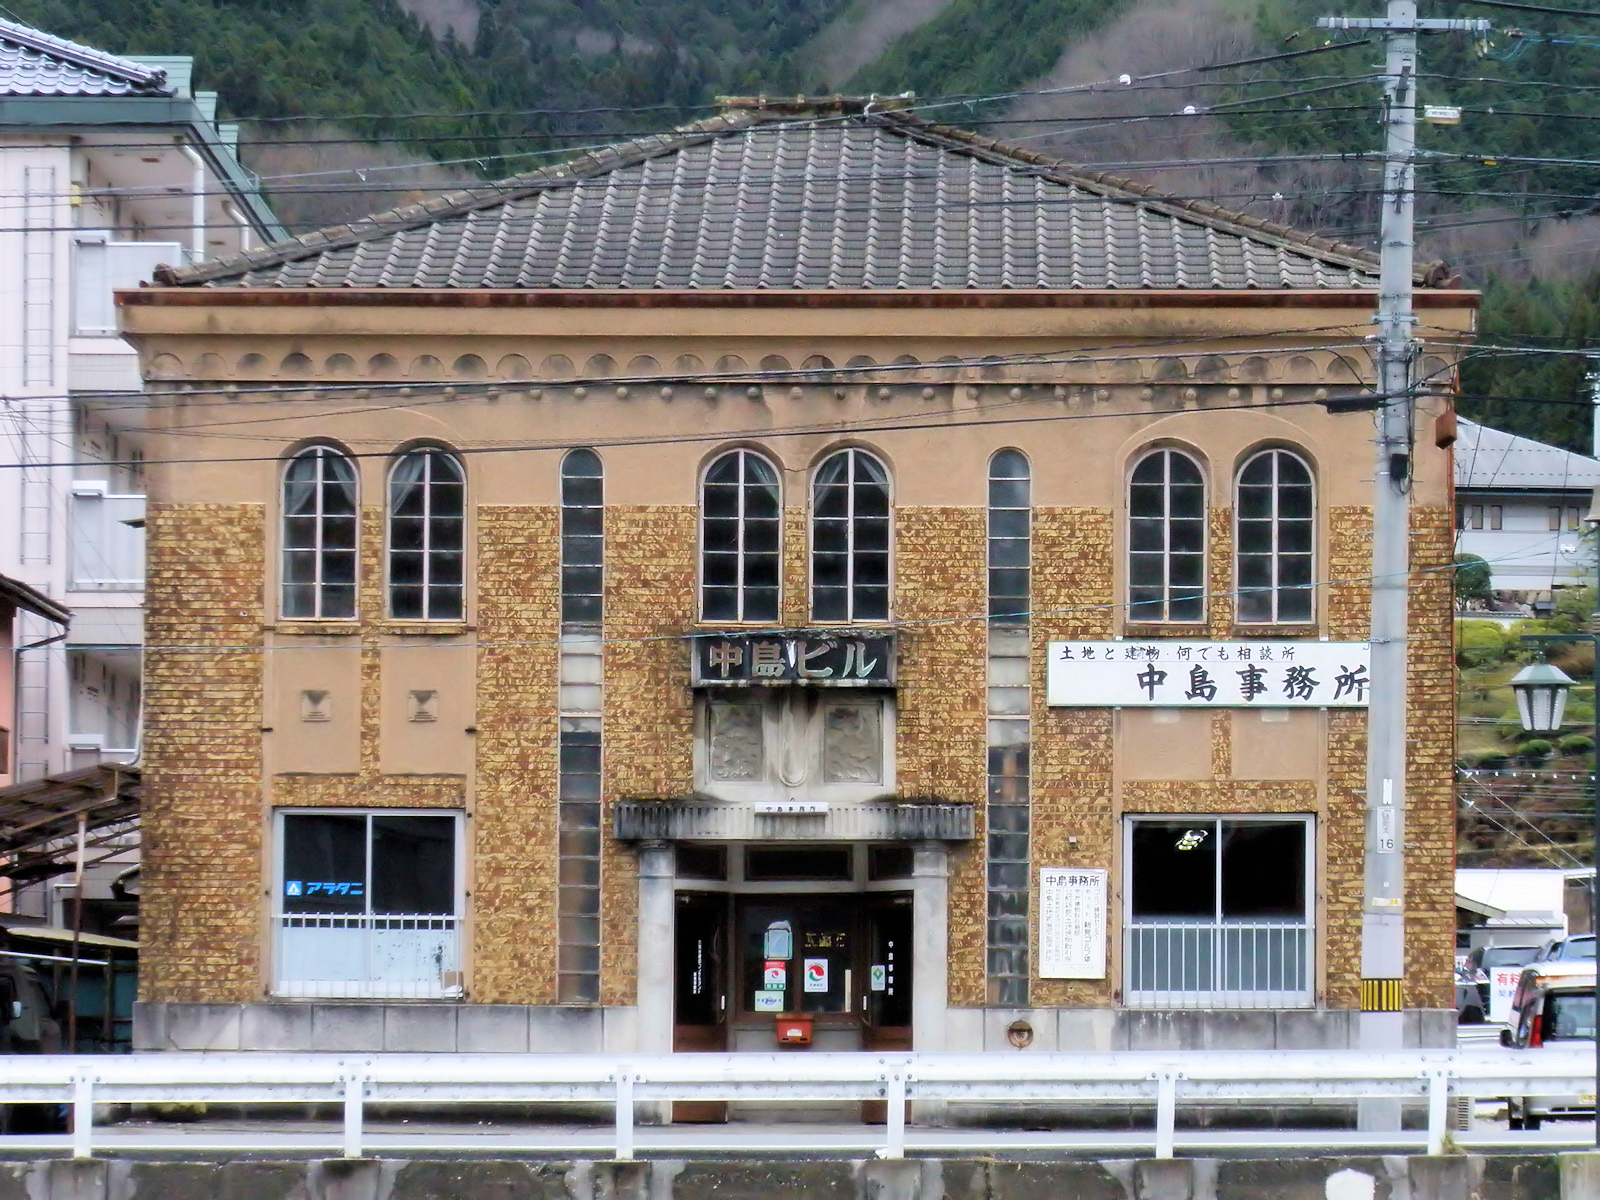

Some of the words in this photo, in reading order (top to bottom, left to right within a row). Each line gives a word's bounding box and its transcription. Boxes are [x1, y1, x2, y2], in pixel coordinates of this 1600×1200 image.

[709, 640, 878, 678] 中島ビル
[1137, 663, 1370, 702] 中島事務所
[1380, 839, 1394, 849] 16
[1045, 875, 1100, 887] 中島事務所
[306, 882, 364, 895] アラタニ
